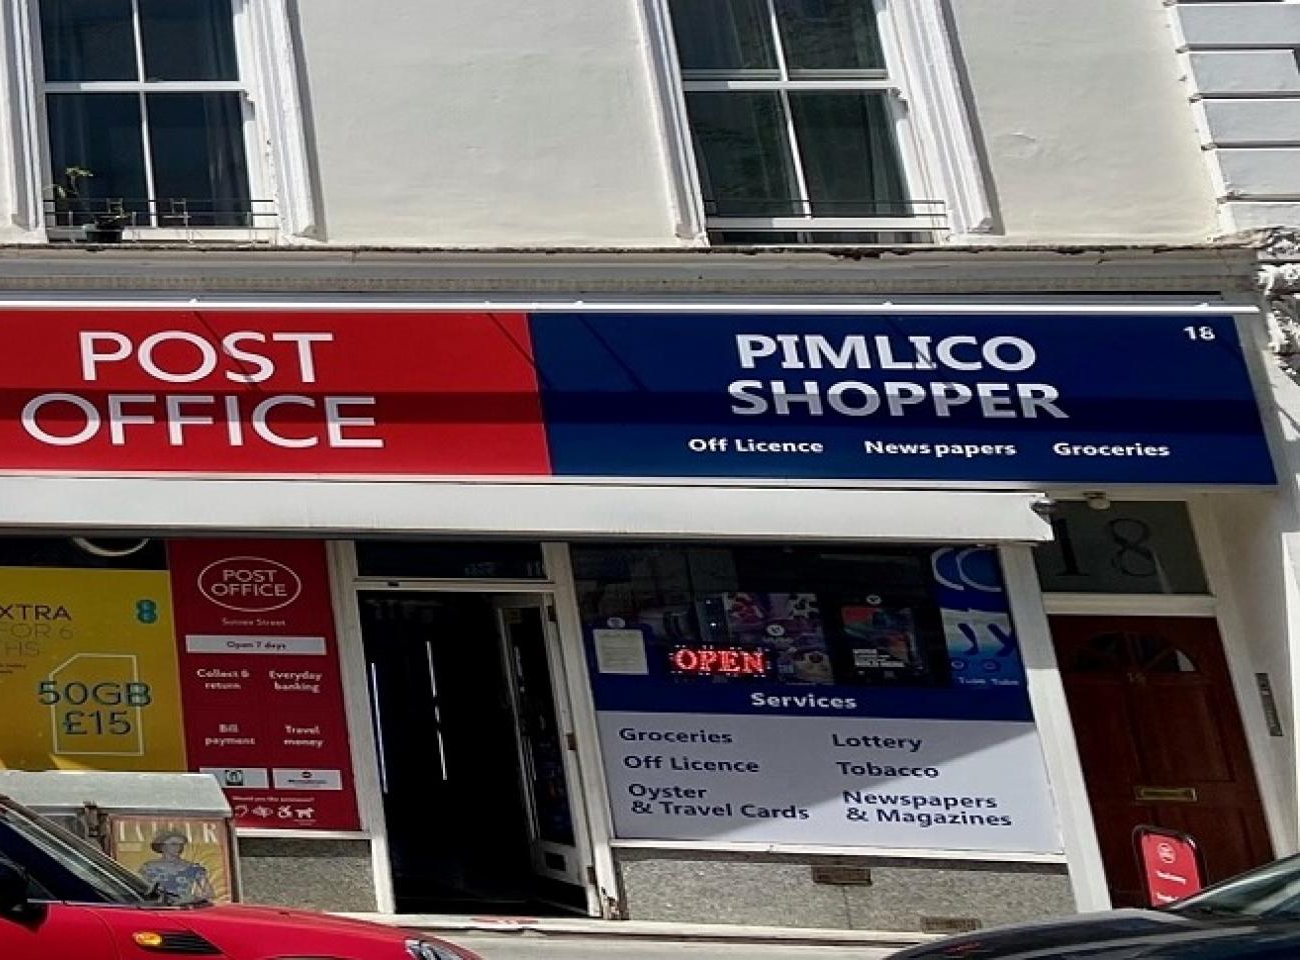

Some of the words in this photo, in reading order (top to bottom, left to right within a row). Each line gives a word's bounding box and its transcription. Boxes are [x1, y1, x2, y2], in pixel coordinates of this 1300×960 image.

[1183, 326, 1215, 340] 18
[79, 330, 333, 383] POST
[736, 334, 1037, 371] PIMLICO
[728, 380, 1070, 418] SHOPPER
[21, 393, 384, 448] OFFICE
[689, 438, 728, 453] Off
[735, 438, 824, 454] Licence
[1053, 442, 1170, 456] Groceries
[1053, 517, 1158, 577] 18
[222, 569, 277, 582] POST
[211, 583, 288, 597] OFFICE
[58, 624, 74, 640] 6
[675, 649, 765, 673] OPEN
[268, 670, 322, 681] Everyday
[38, 680, 152, 707] 50GB
[274, 681, 321, 693] banking
[751, 692, 857, 709] Services
[62, 710, 132, 735] £15
[285, 725, 320, 735] Travel
[205, 737, 256, 747] payment
[618, 727, 733, 743] Groceries
[832, 733, 922, 752] Lottery
[624, 755, 663, 769] Off
[670, 756, 761, 773] Licence
[836, 761, 939, 778] Tobacco
[628, 783, 707, 800] Oyster
[842, 790, 998, 810] Newspapers
[630, 801, 652, 815] &
[659, 801, 733, 817] Travel
[741, 804, 810, 819] Cards
[845, 807, 869, 822] &
[876, 808, 1013, 828] Magazines
